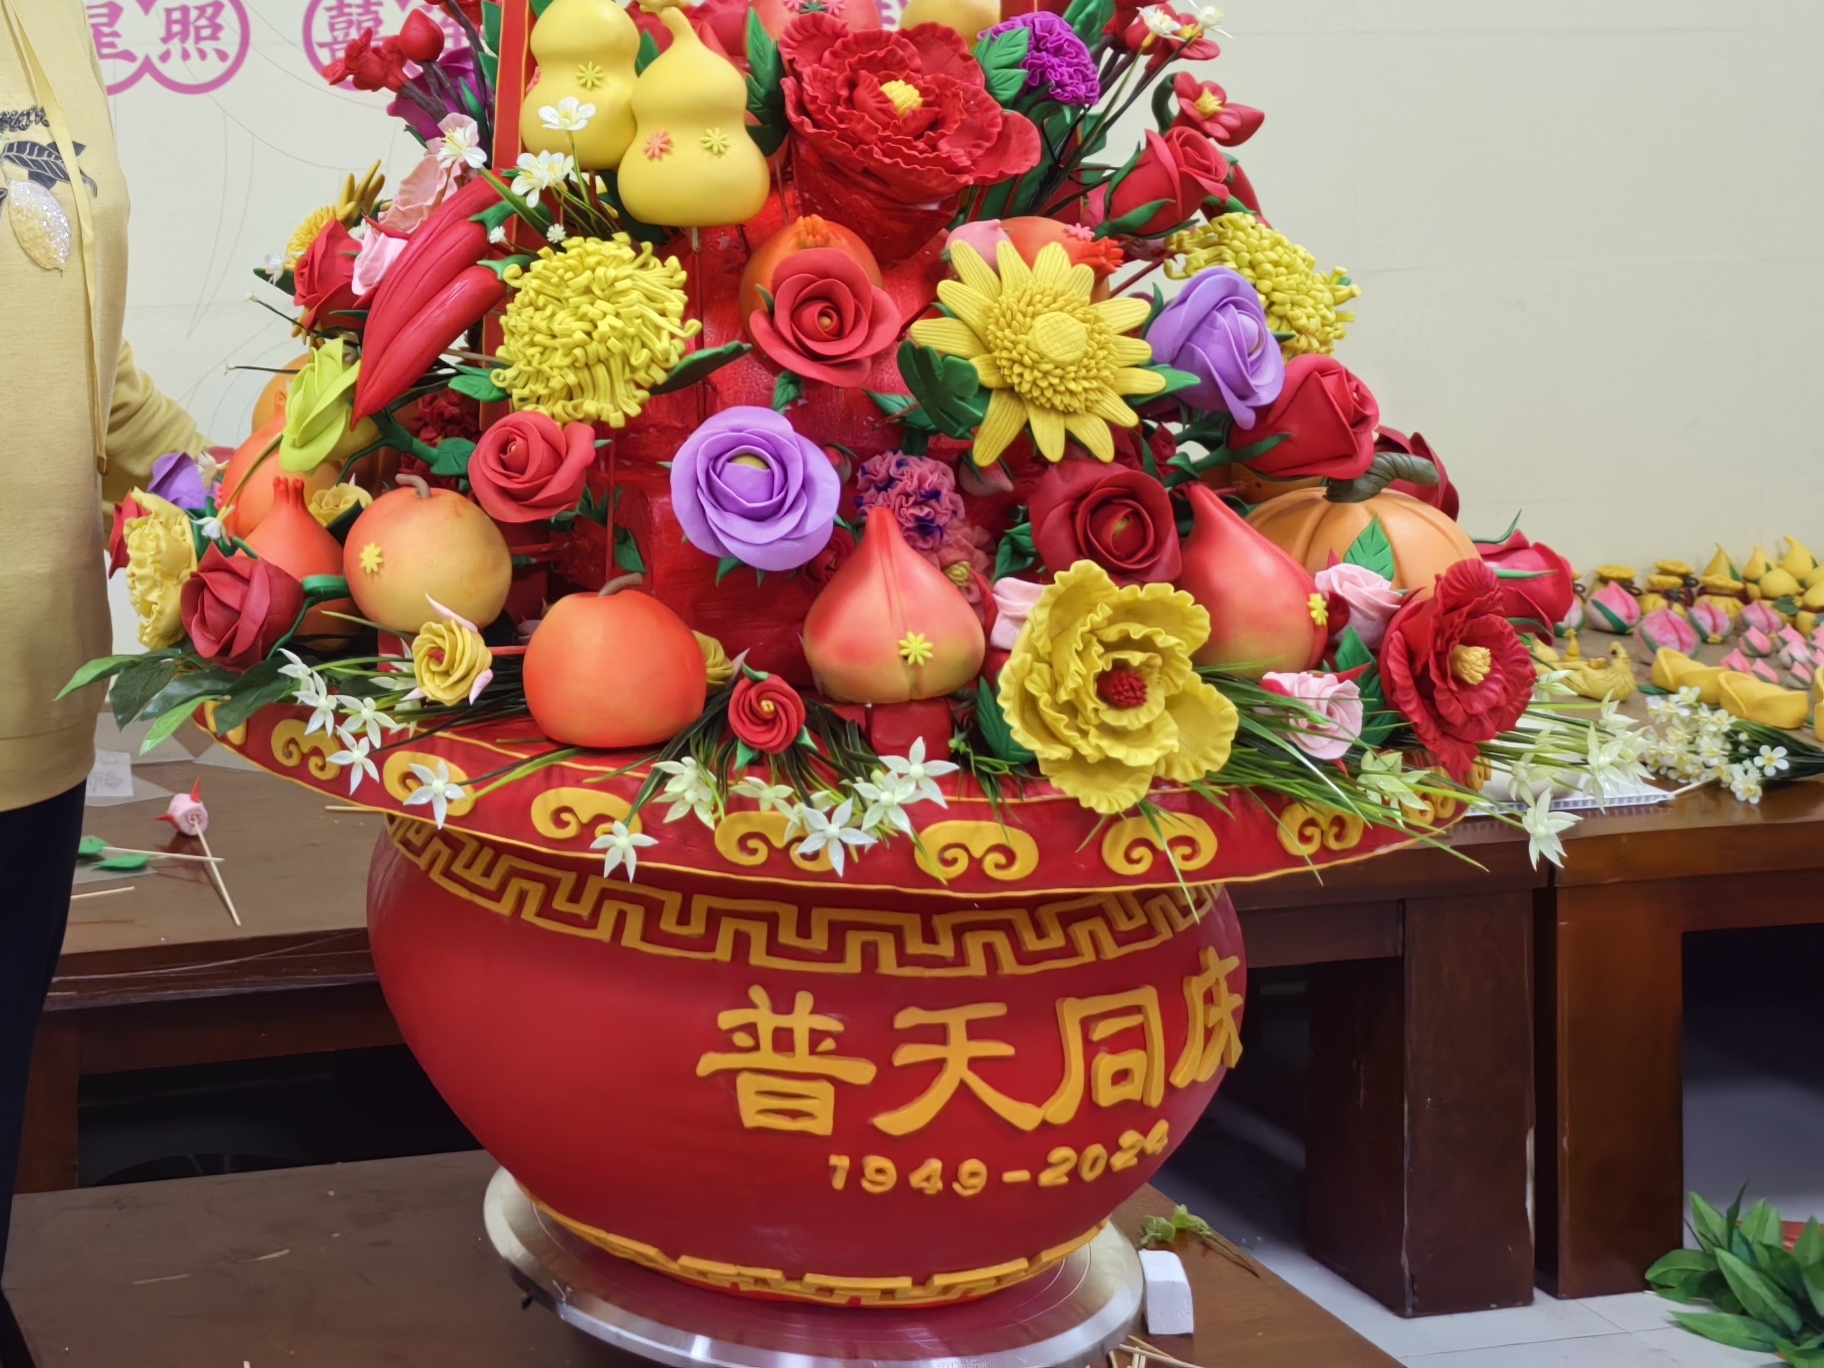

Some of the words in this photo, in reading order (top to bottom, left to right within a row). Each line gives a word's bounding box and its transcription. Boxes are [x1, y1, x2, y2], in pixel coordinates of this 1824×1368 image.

[696, 944, 1244, 1135] 普天同庆
[828, 1118, 1170, 1196] 1949-2024
